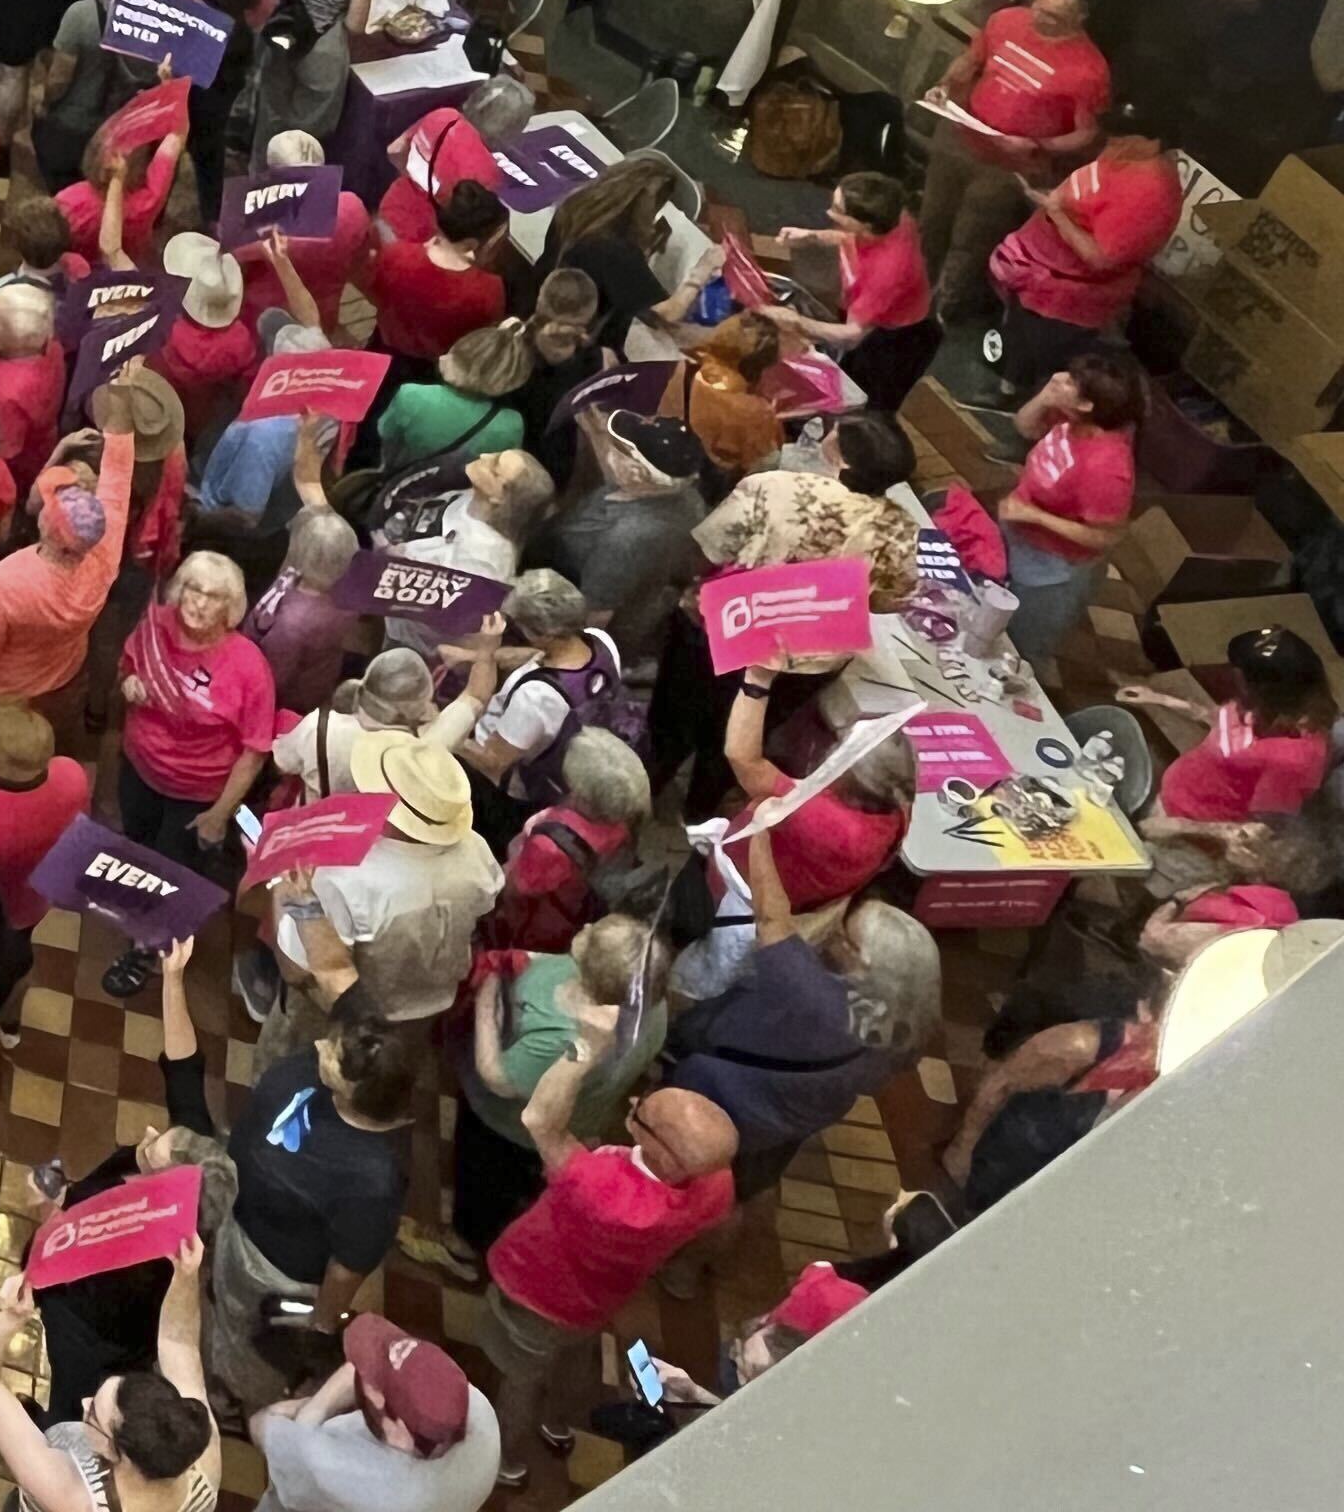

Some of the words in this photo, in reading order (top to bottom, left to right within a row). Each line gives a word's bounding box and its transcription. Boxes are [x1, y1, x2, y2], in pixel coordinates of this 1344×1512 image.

[244, 182, 308, 215] EVERY
[378, 569, 467, 590] EVERY
[85, 852, 180, 896] EVERY
